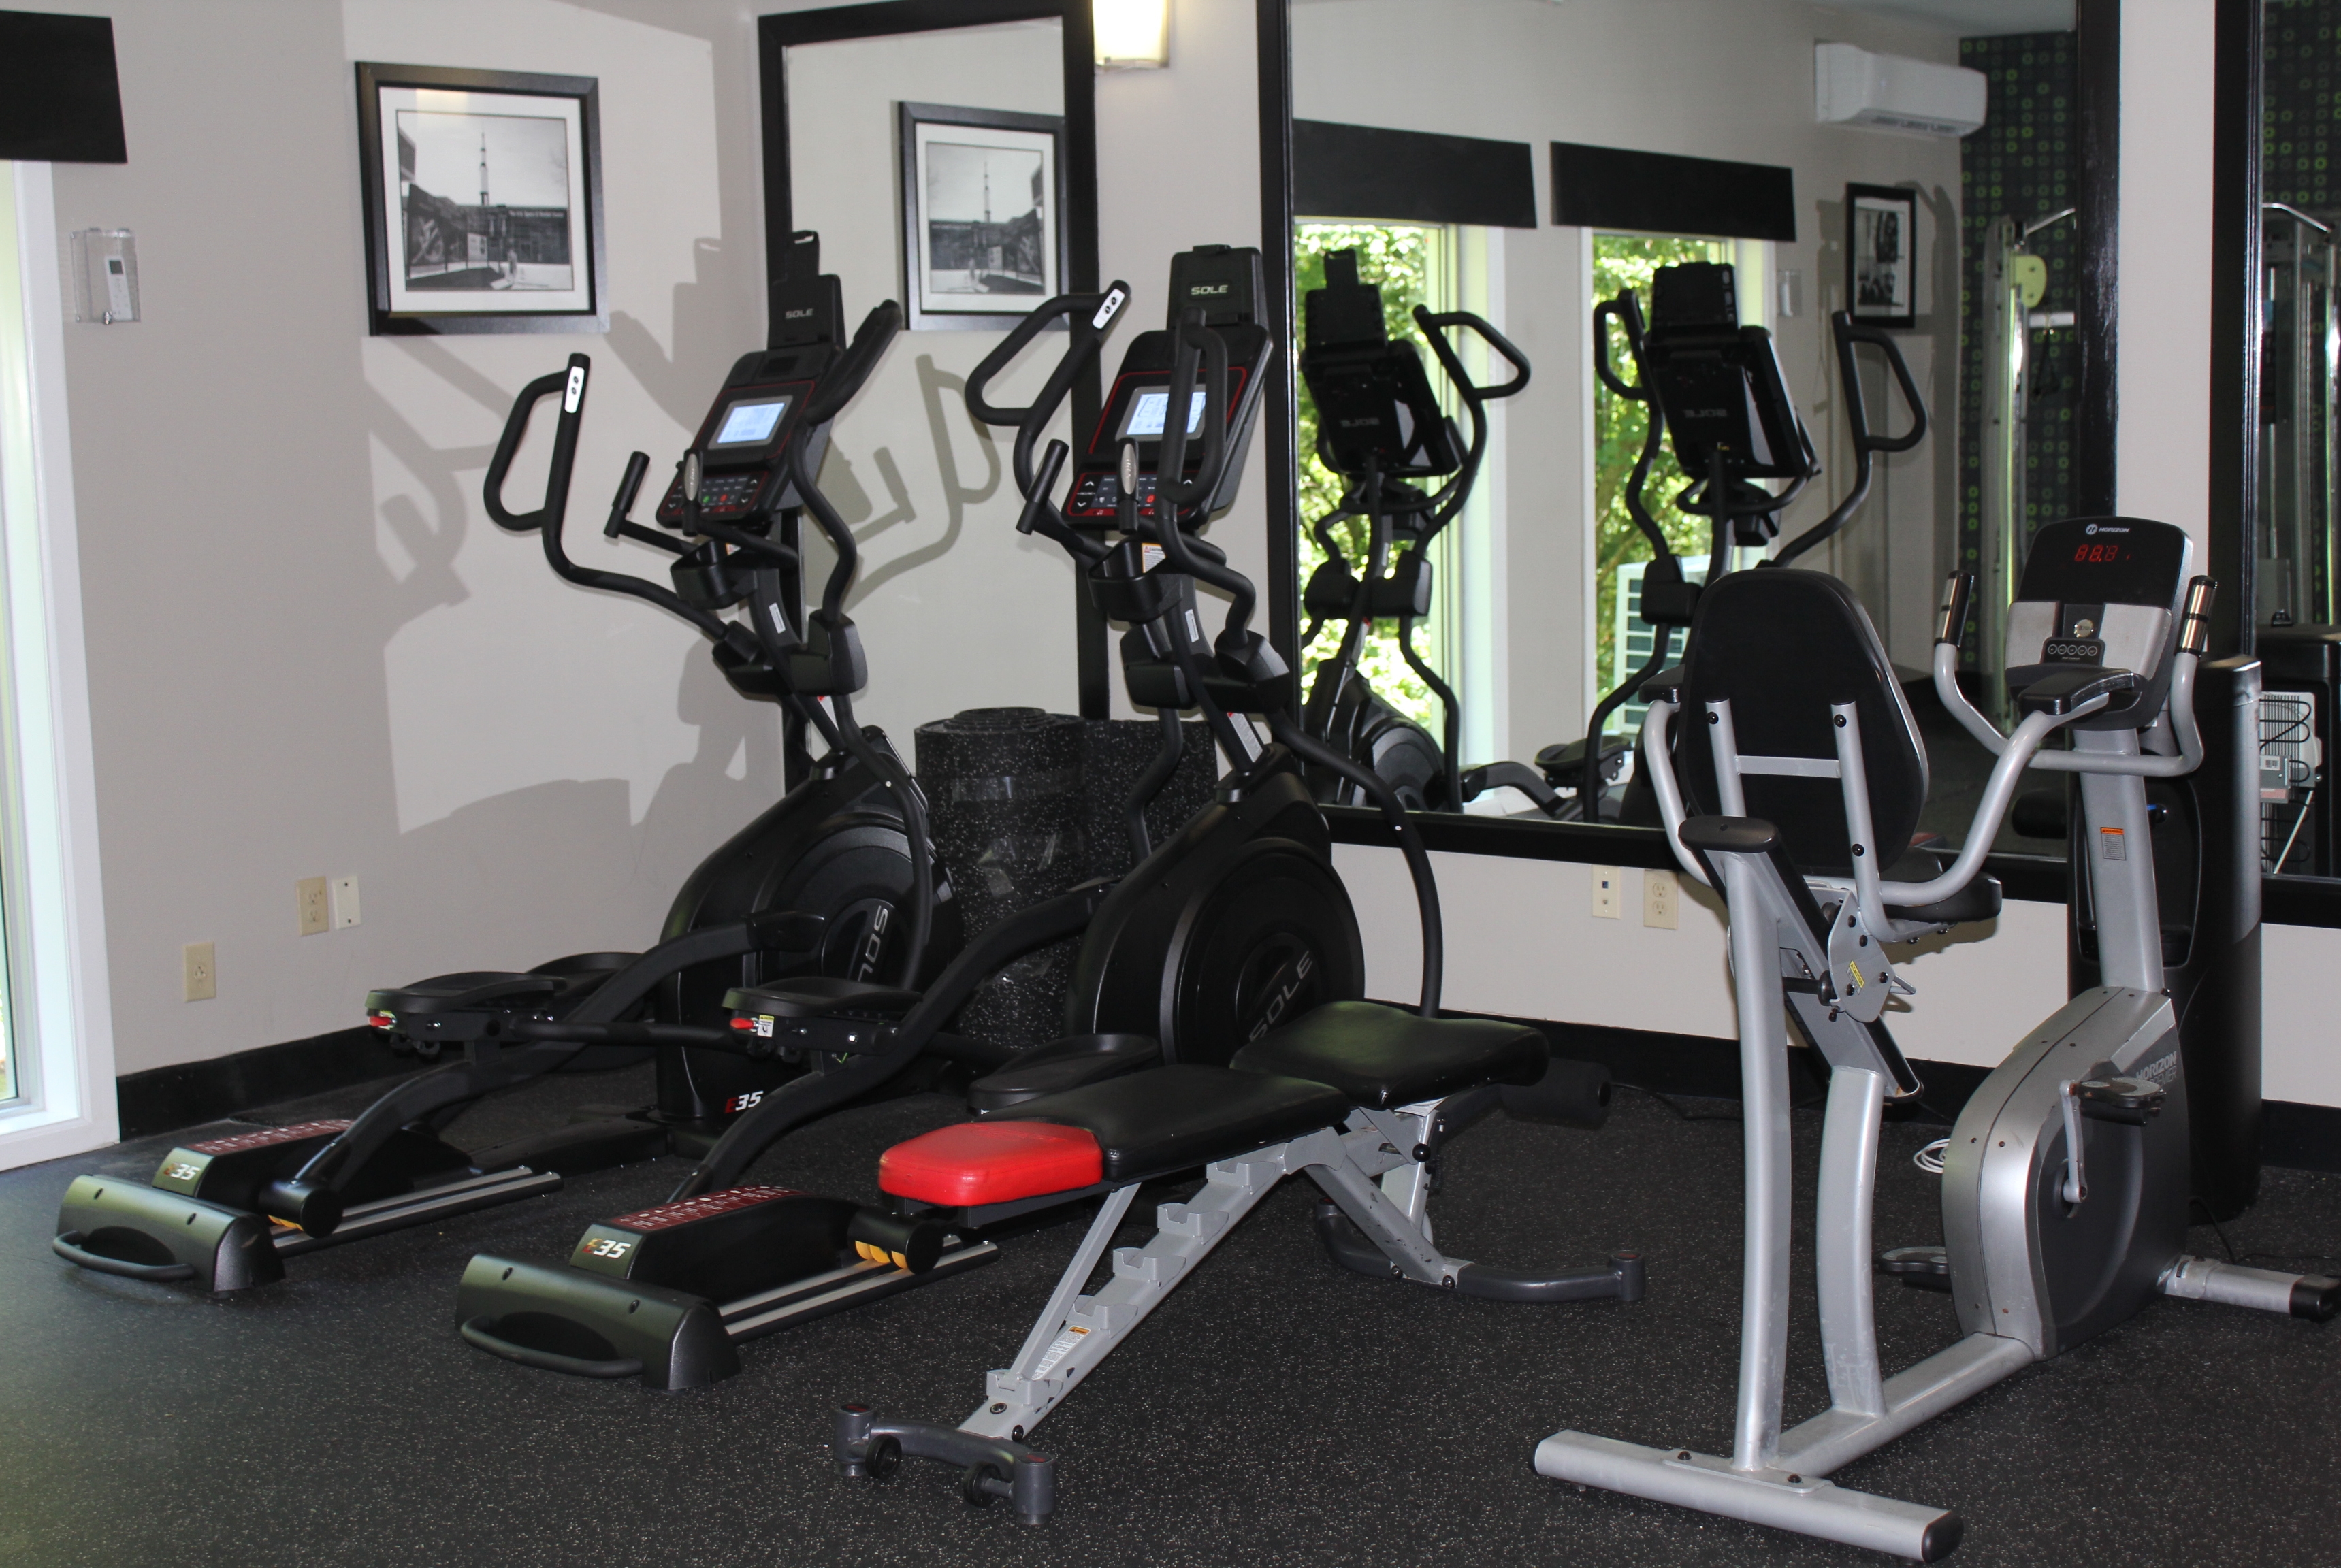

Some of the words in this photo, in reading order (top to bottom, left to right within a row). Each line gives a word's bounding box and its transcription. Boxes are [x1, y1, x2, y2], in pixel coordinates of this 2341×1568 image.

[1191, 284, 1228, 295] SOLE
[786, 308, 813, 319] SOLE
[858, 905, 888, 982] SOL
[1249, 950, 1312, 1042] SOLE
[2136, 1051, 2176, 1081] HORIZON
[724, 1090, 764, 1114] E35
[582, 1237, 632, 1259] E35
